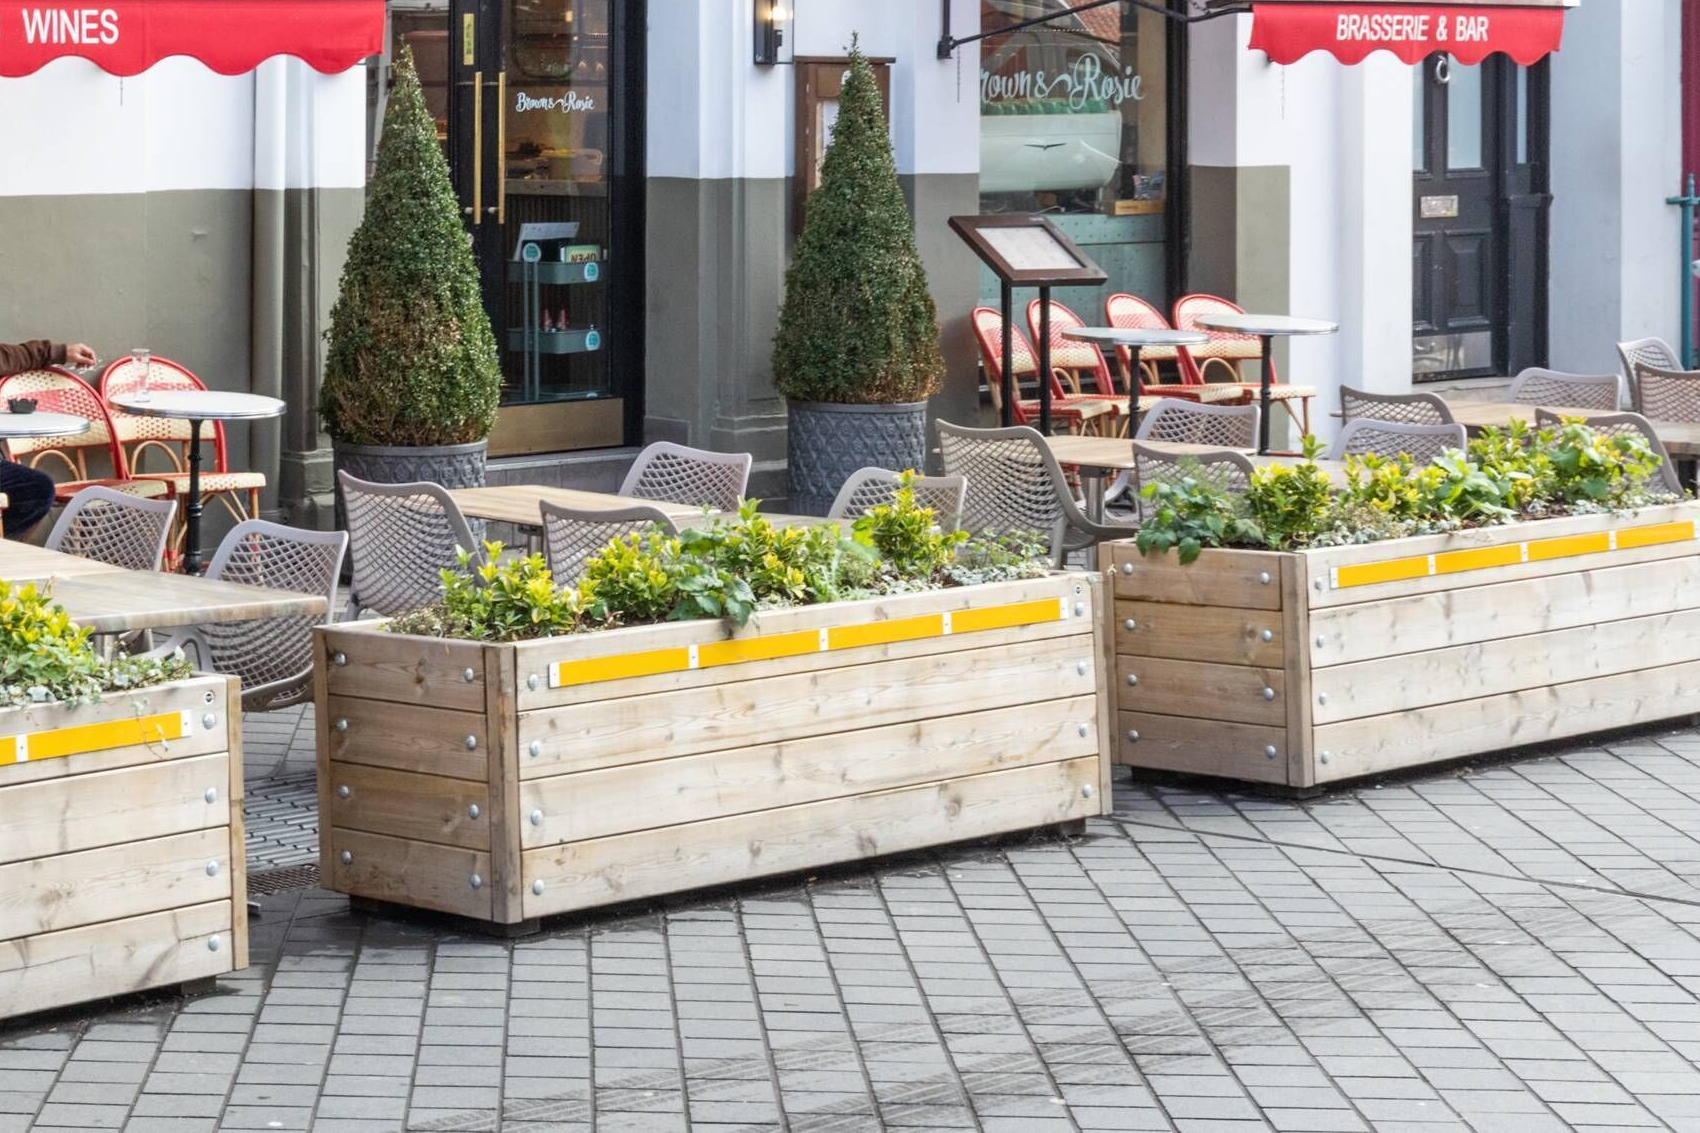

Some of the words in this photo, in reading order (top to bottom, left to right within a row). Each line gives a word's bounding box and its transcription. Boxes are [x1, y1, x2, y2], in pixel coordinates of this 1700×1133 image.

[21, 8, 120, 44] WINES
[1335, 14, 1431, 41] BRASSERIE
[1435, 15, 1448, 42] &
[1455, 15, 1489, 42] BAR
[980, 68, 1032, 104] rown
[1069, 52, 1148, 110] Rosie
